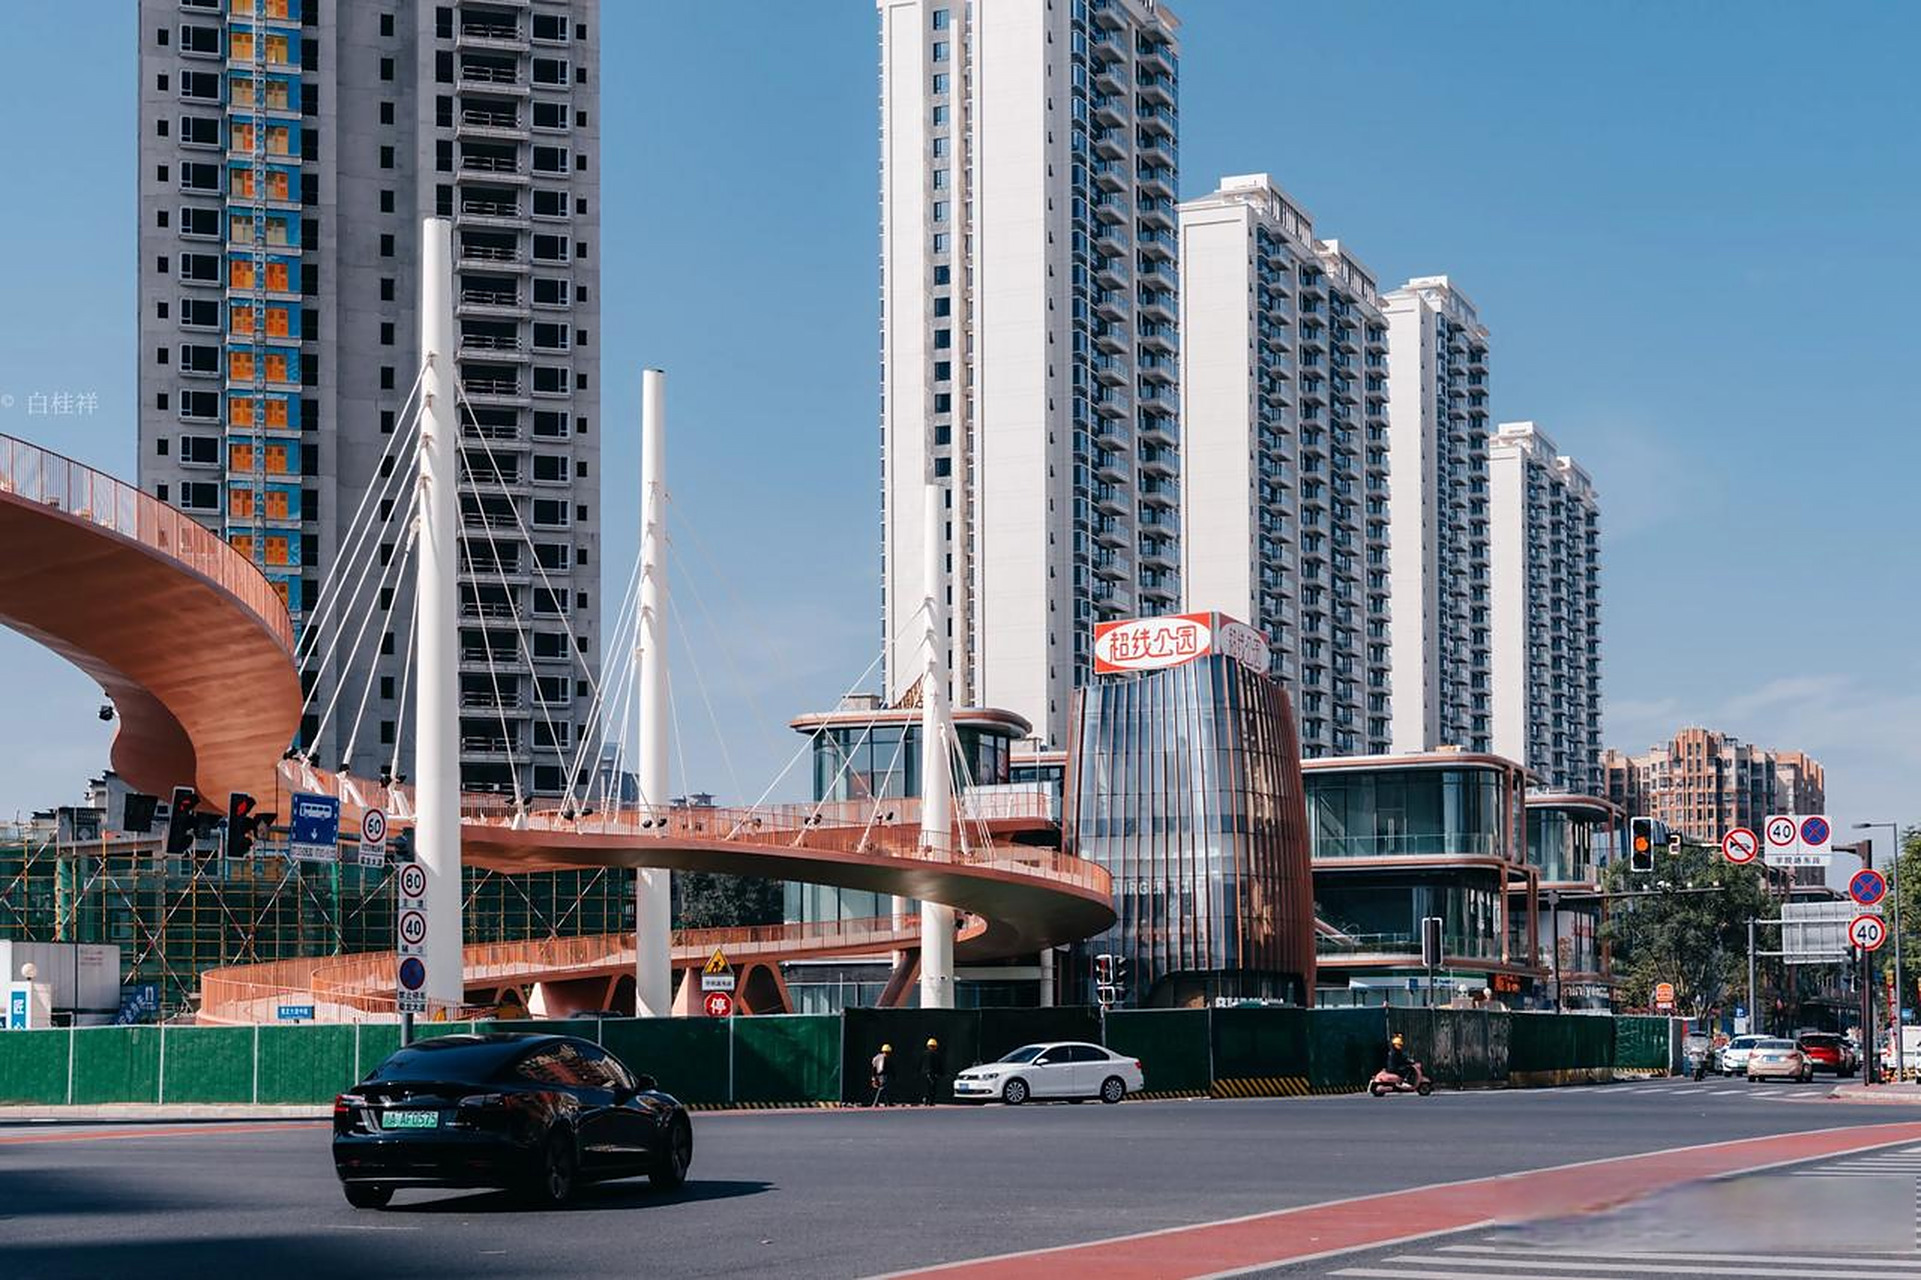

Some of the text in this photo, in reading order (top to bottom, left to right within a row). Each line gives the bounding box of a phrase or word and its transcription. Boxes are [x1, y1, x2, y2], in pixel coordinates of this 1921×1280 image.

[1109, 625, 1198, 662] 超线公园
[367, 818, 381, 834] 60
[1772, 825, 1791, 839] 40
[405, 873, 421, 889] 80
[405, 920, 421, 936] 40
[1856, 925, 1878, 941] 40
